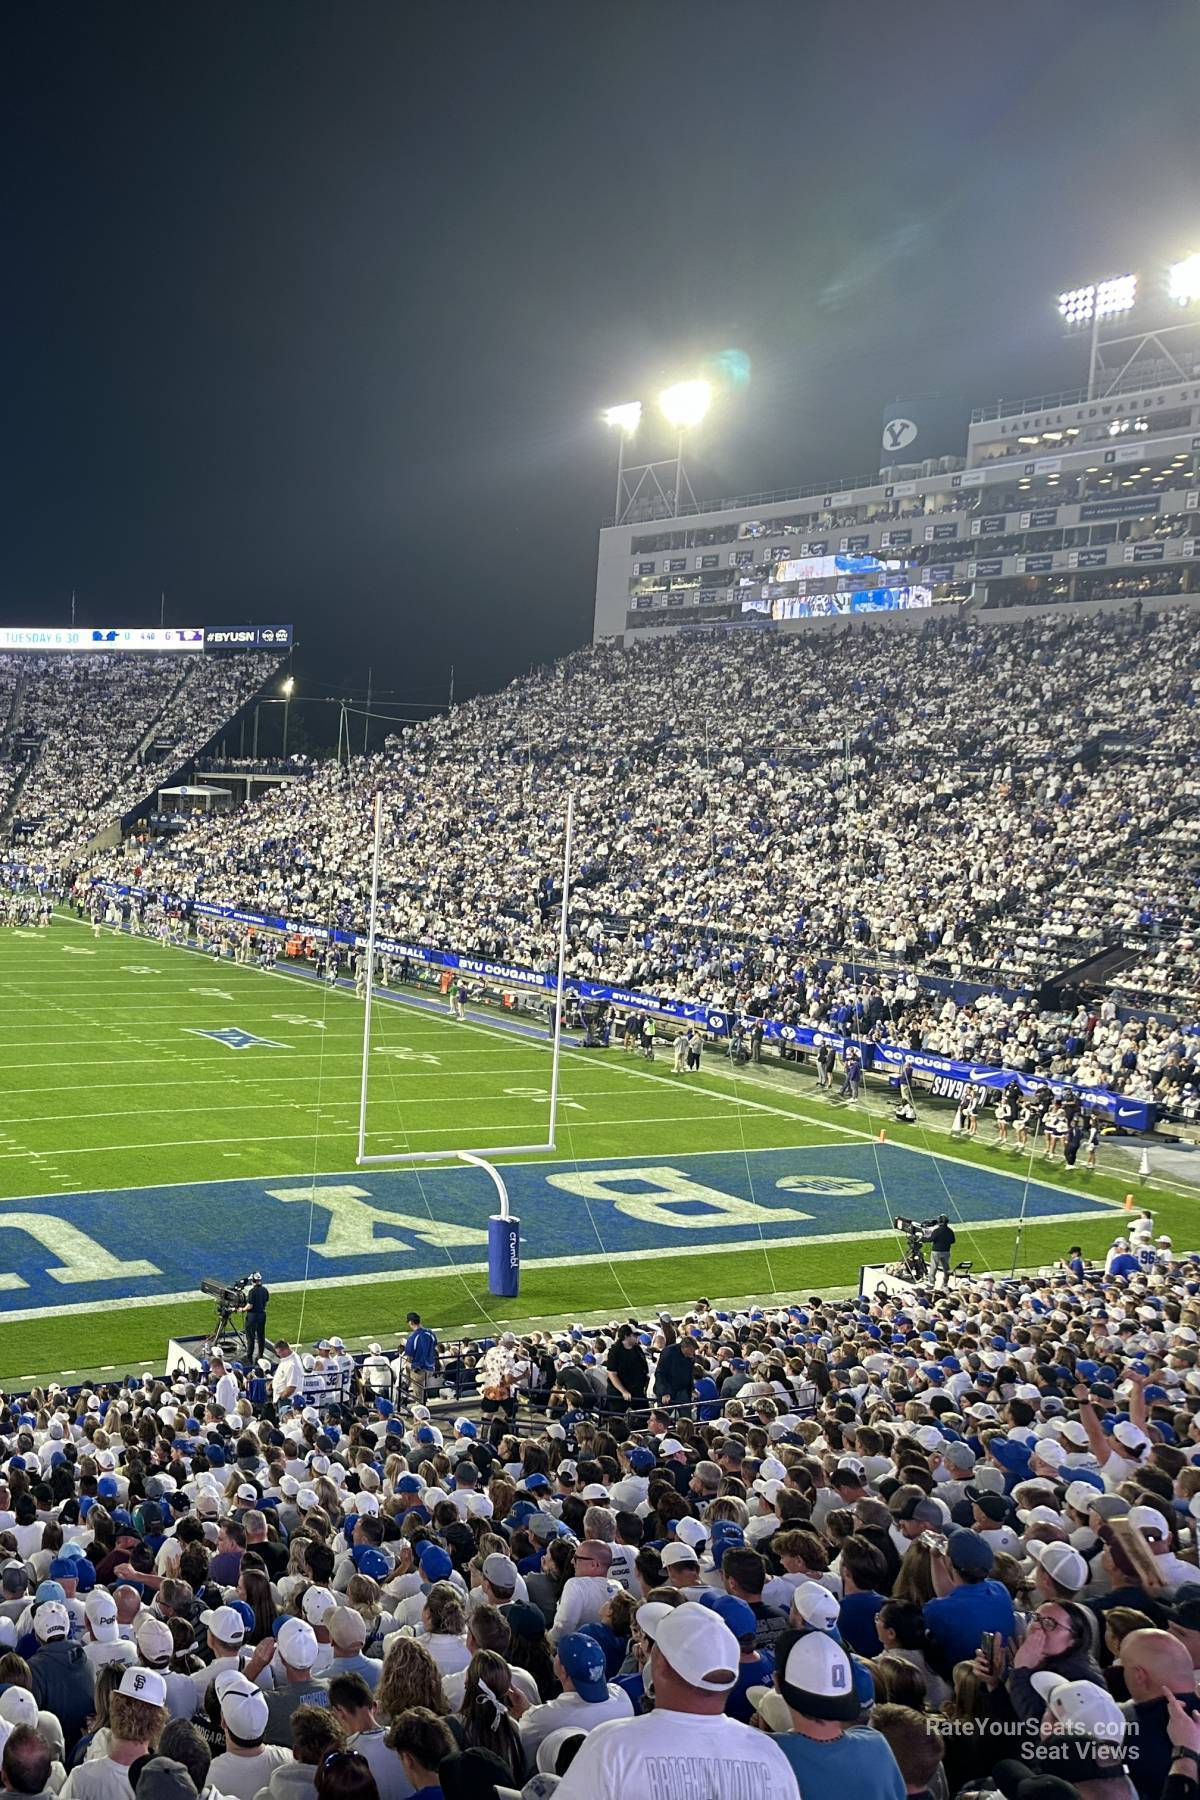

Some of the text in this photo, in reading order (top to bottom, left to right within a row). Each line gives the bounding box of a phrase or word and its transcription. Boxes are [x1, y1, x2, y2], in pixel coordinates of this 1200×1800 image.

[1001, 415, 1063, 434] LAVELL
[1077, 395, 1166, 419] EDWARDS
[5, 632, 51, 644] TUESDAY
[207, 631, 255, 643] #BYUSN
[286, 922, 329, 938] GO COUGS
[459, 959, 545, 986] BYU COUGARS
[611, 991, 677, 1012] BYU FOOTBLL
[884, 1049, 951, 1071] GO COUGS
[932, 1076, 987, 1106] CUGARS
[510, 1232, 519, 1269] crumbl
[1141, 1252, 1156, 1264] 96
[831, 1664, 846, 1689] Q
[645, 1757, 773, 1800] BRIGHAM YOUNG
